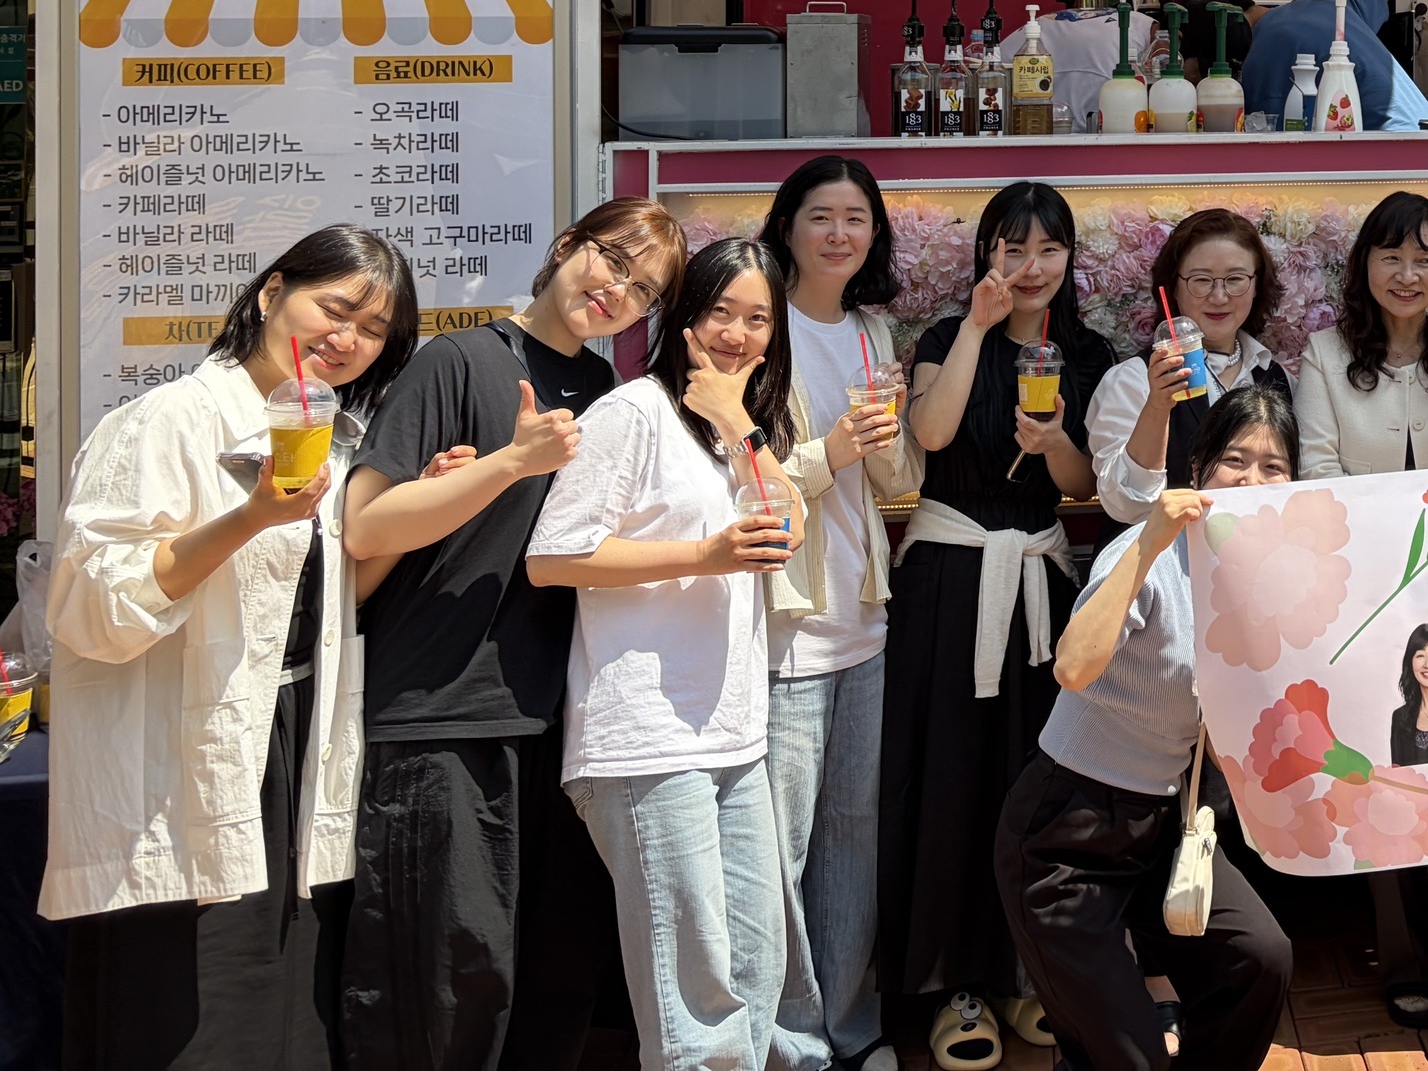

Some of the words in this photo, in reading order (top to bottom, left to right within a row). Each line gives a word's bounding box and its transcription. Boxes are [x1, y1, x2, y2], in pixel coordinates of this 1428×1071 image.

[134, 60, 273, 84] 커피(COFFEE)
[373, 57, 494, 81] 음료(DRINK)
[117, 103, 230, 127] 아메리카노
[370, 100, 460, 124] 오곡라떼
[117, 133, 186, 157] 바닐라
[190, 132, 304, 155] 아메리카노
[370, 131, 460, 155] 녹차라떼
[118, 163, 207, 187] 헤이즐넛
[212, 161, 326, 185] 아메리카노
[370, 162, 460, 185] 초코라떼
[117, 193, 207, 216] 카페라떼
[370, 194, 460, 217] 딸기라떼
[117, 224, 185, 247] 바닐라
[190, 222, 235, 245] 라떼
[421, 223, 533, 247] 고구마라떼
[118, 253, 208, 277] 헤이즐넛
[212, 252, 258, 275] 라떼
[444, 255, 488, 278] 라떼
[117, 284, 185, 307] 카라멜
[164, 320, 221, 342] 차(TE
[118, 363, 186, 386] 복숭아
